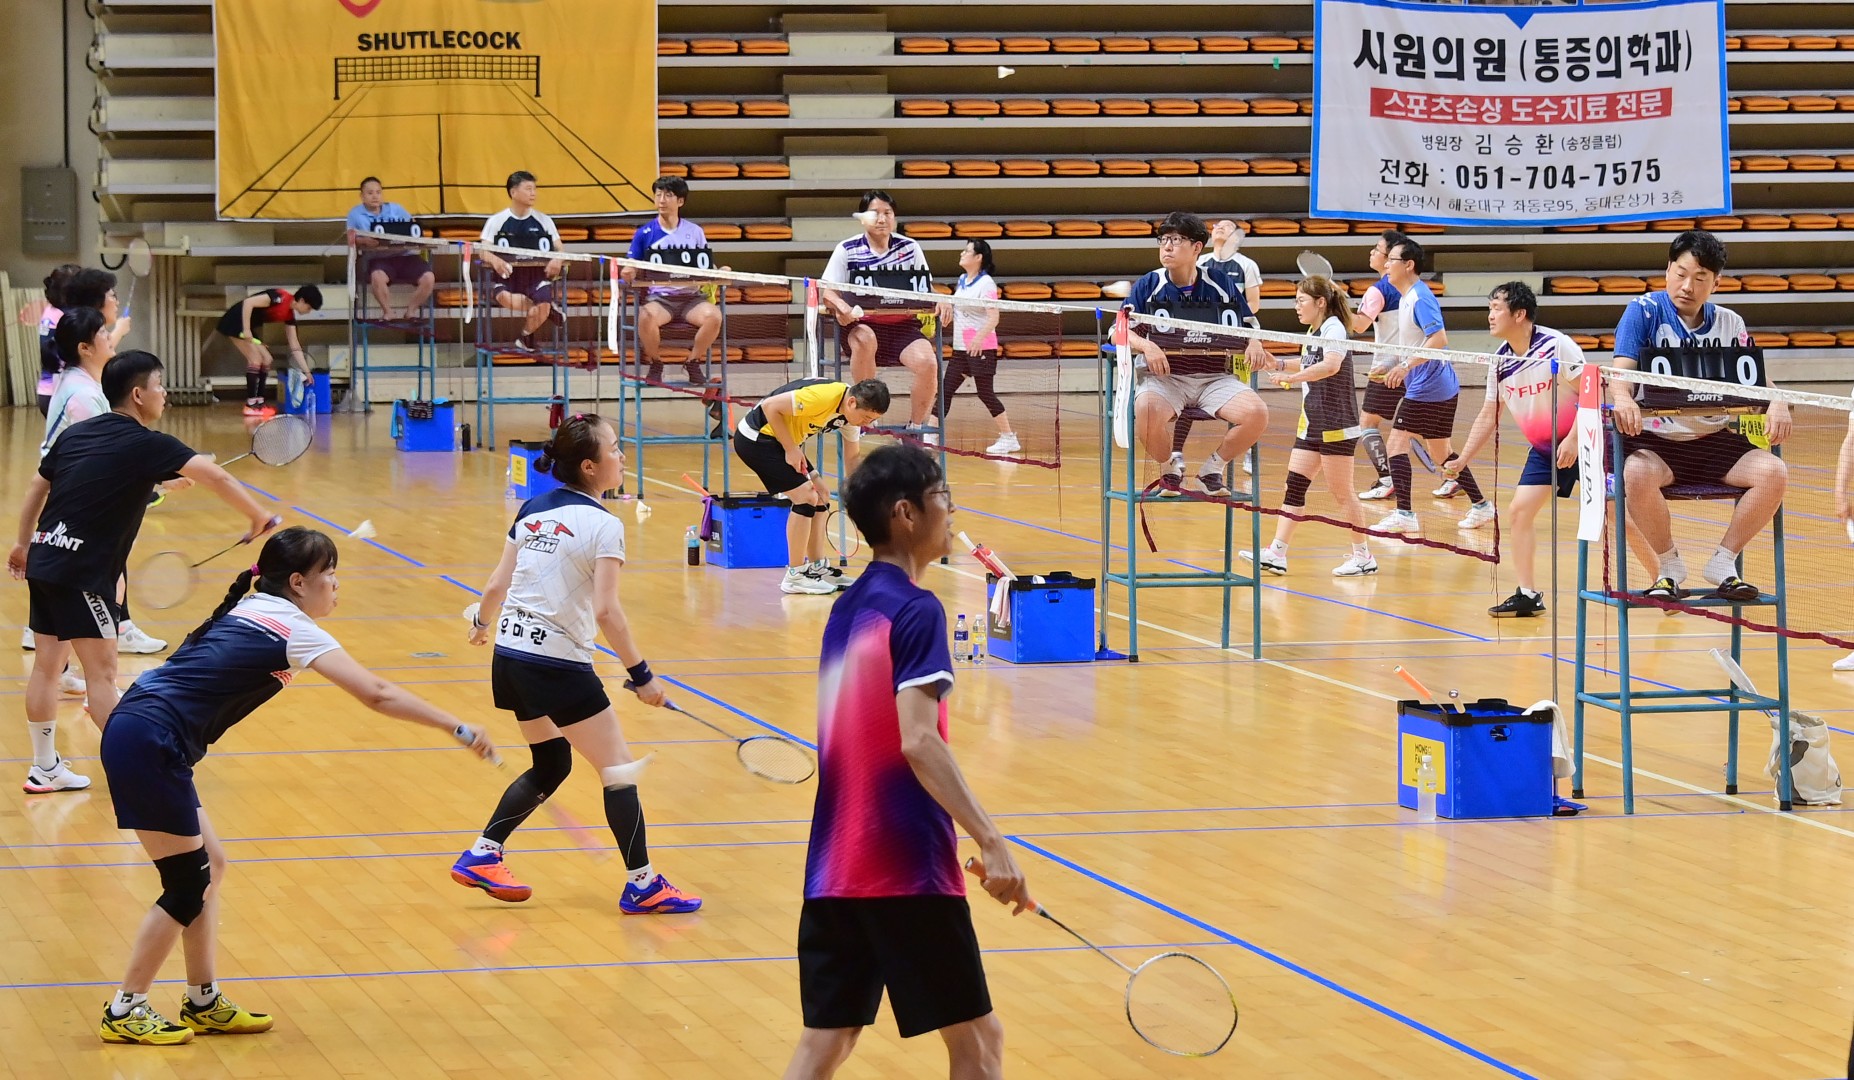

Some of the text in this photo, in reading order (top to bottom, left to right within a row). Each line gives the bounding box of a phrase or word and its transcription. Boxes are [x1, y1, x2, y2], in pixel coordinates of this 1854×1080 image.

[358, 31, 521, 50] SHUTTLECOCK
[1353, 29, 1692, 83] 시원의원 (통증의학과)
[1383, 91, 1663, 123] 스포츠손상 도수치료 전문
[1421, 135, 1463, 152] 병원장
[1561, 134, 1623, 152] (송정클럽)
[1380, 159, 1429, 188] 전화
[1456, 158, 1661, 189] 051-704-7575
[1368, 190, 1684, 213] 부산광역시 해운대구 좌동로95, 동대문상가 3층
[411, 223, 421, 238] 0
[538, 236, 551, 252] 0
[681, 251, 691, 264] 0
[697, 252, 710, 270] 0
[909, 275, 928, 293] 14
[1221, 309, 1238, 328] 0
[1183, 336, 1212, 344] SPORTS
[1736, 355, 1758, 386] 0
[1584, 376, 1591, 394] 3
[1687, 393, 1724, 402] SPORTS
[1369, 440, 1388, 471] FLPA
[1584, 445, 1592, 505] FLPA
[31, 522, 84, 551] NEPOINT
[525, 535, 559, 554] TEAM
